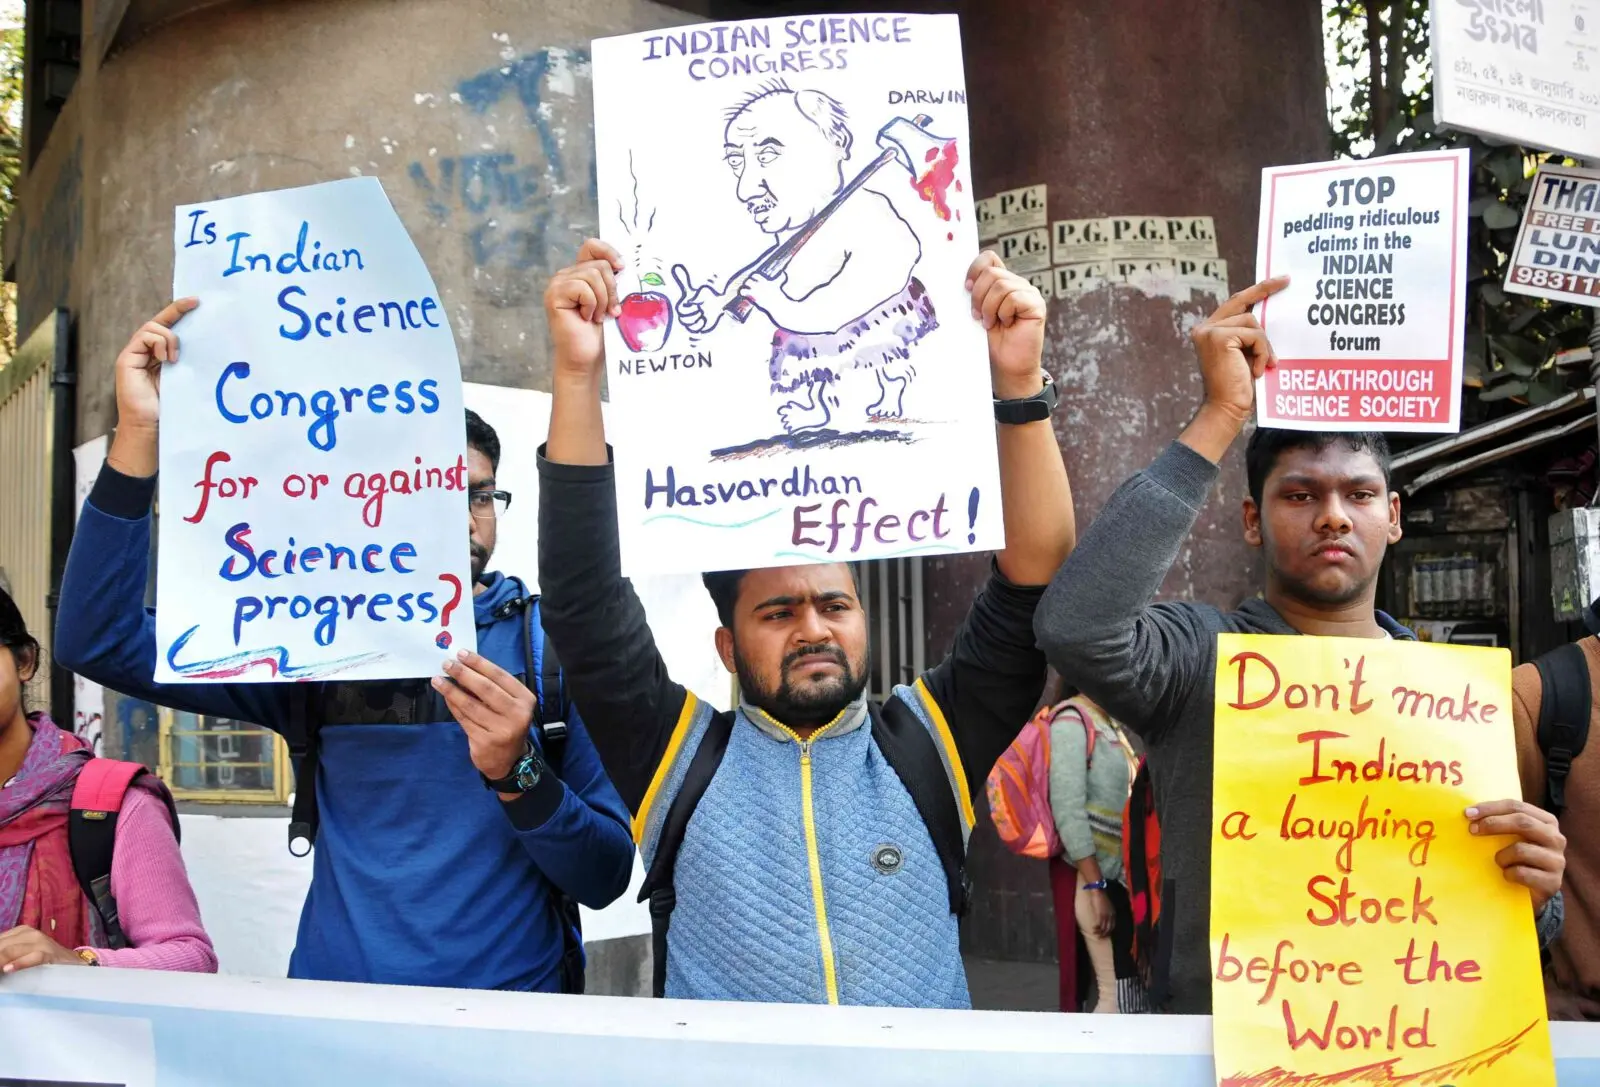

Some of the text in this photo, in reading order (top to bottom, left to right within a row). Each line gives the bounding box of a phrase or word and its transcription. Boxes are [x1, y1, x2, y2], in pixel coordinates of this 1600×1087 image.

[642, 17, 911, 60] INDIAN SCIENCE
[688, 48, 848, 80] CONGRESS
[888, 89, 966, 105] DARWIN
[1000, 188, 1044, 215] P.G.
[1326, 175, 1396, 208] STOP
[184, 210, 216, 248] Is
[1057, 221, 1109, 244] P.G.
[1113, 219, 1164, 240] P.G.
[1167, 219, 1212, 240] P.G.
[1284, 207, 1440, 238] peddling ridiculous
[1532, 212, 1586, 232] FREE
[223, 221, 364, 277] Indian
[1003, 232, 1047, 258] P.G.
[1308, 231, 1412, 254] claims in the
[1323, 253, 1393, 275] INDIAN
[1315, 278, 1393, 300] SCIENCE
[1516, 267, 1600, 296] 98311
[278, 286, 440, 340] Science
[1307, 303, 1405, 325] CONGRESS
[1330, 331, 1380, 351] forum
[618, 351, 713, 375] NEWTON
[1278, 369, 1433, 391] BREAKTHROUGH
[215, 361, 440, 451] Congress
[1275, 395, 1440, 418] SCIENCE SOCIETY
[183, 451, 467, 527] for or against
[644, 464, 862, 510] Hasvardhan
[220, 522, 418, 581] Science
[234, 574, 462, 649] progress?
[1227, 651, 1499, 724] Don't make
[1297, 730, 1464, 786] Indians
[1220, 794, 1437, 873] a laughing
[1306, 874, 1438, 926] Stock
[1216, 933, 1483, 1006] before the
[1282, 998, 1437, 1051] World
